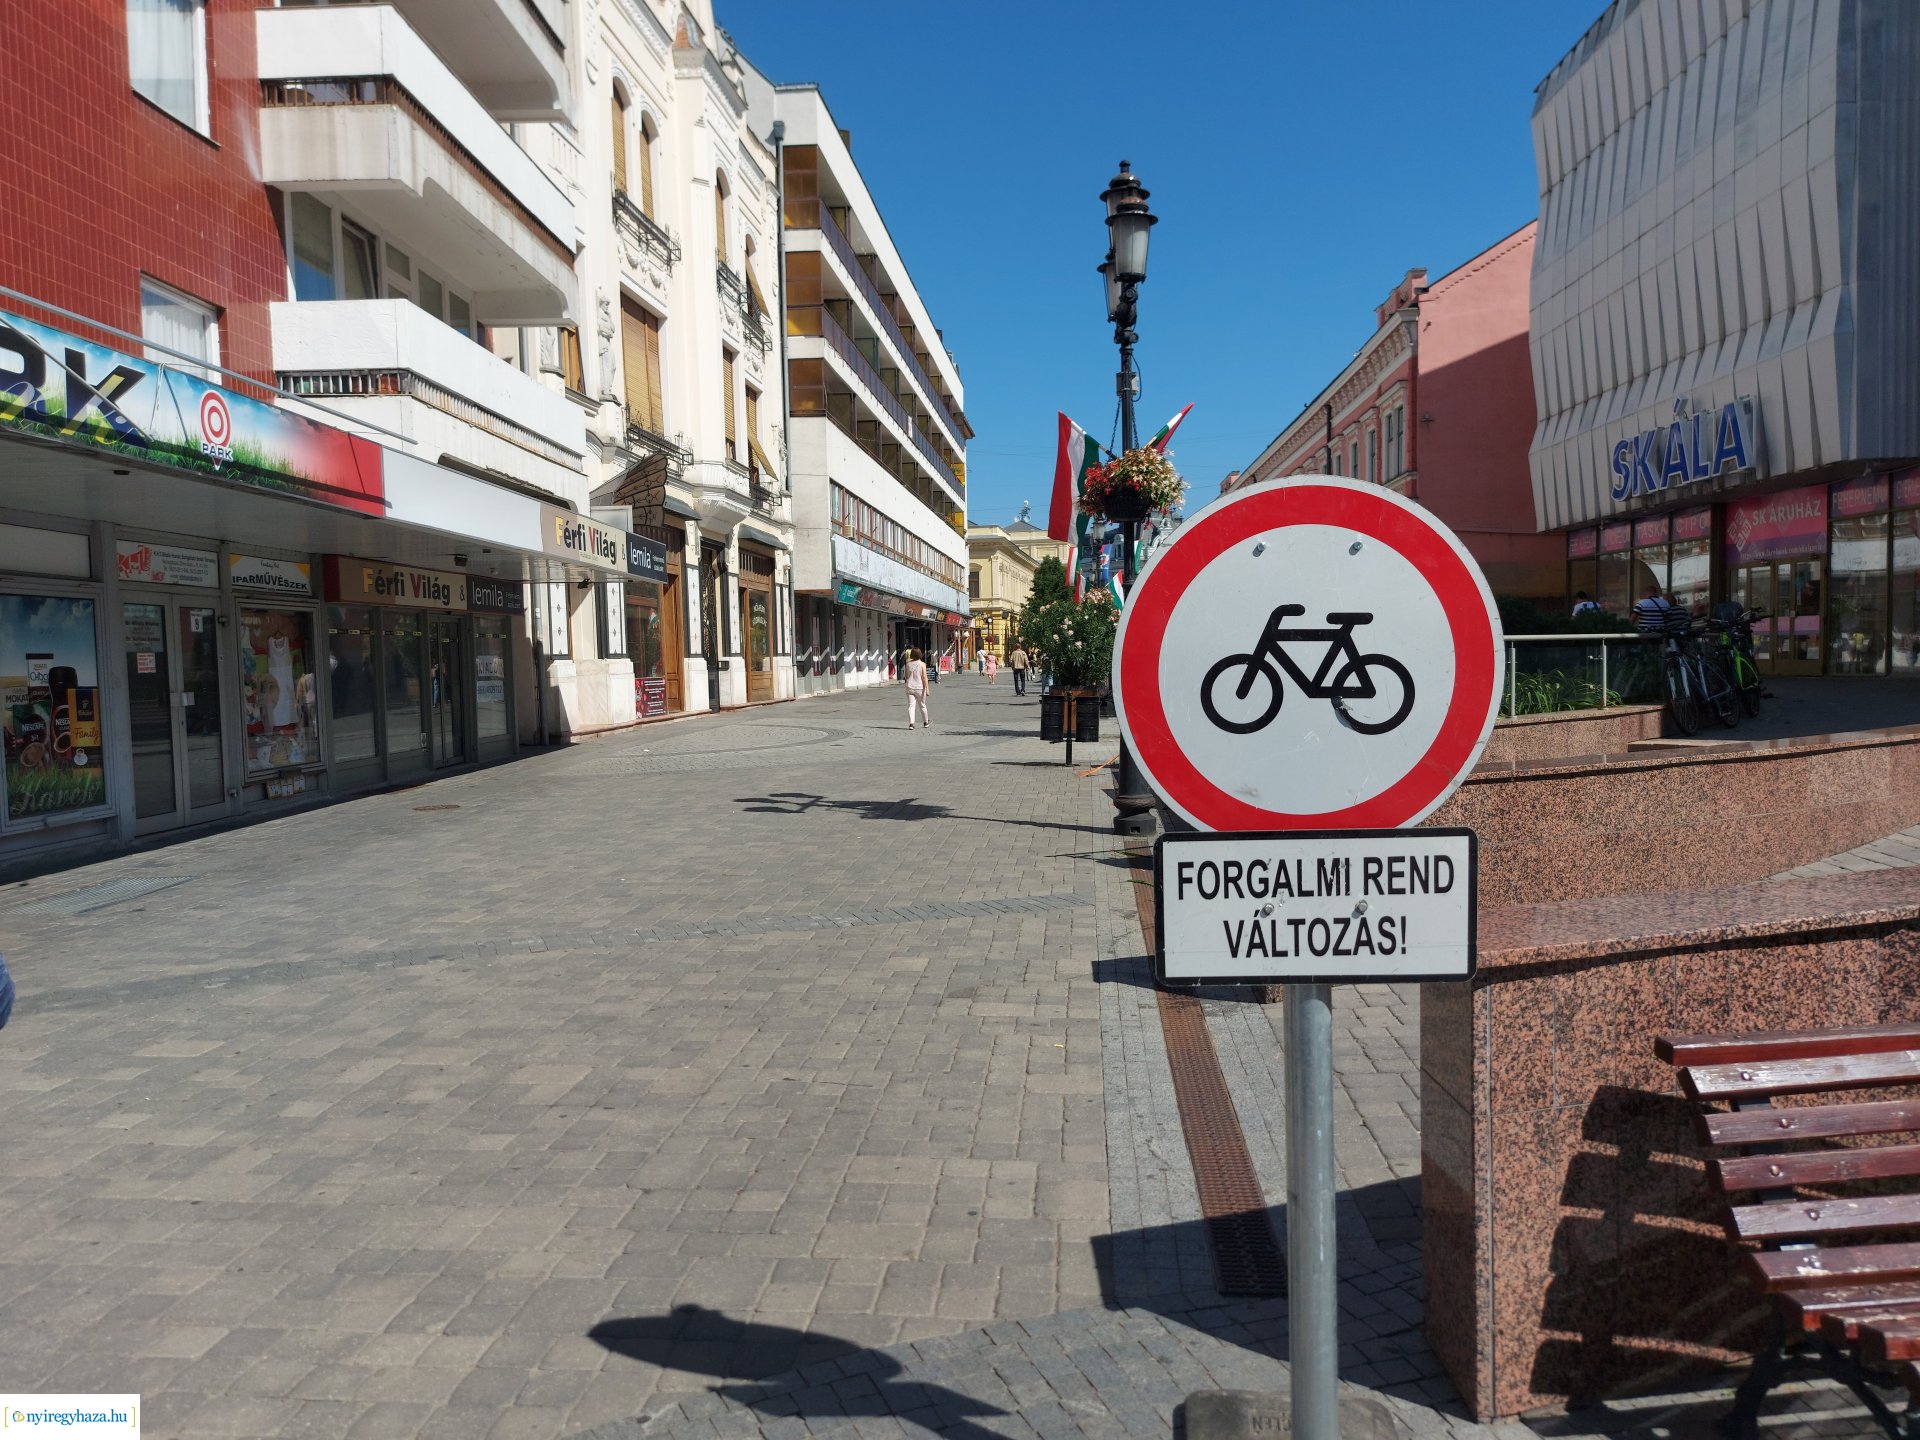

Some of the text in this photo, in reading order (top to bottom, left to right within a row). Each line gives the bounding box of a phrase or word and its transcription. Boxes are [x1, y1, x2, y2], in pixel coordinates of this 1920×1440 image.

[202, 442, 233, 461] PARK
[1611, 397, 1748, 501] SKÁLA
[1752, 496, 1822, 526] SK ÁRUHÁZ
[555, 515, 587, 552] Férfi
[588, 526, 617, 566] Világ
[232, 572, 308, 590] IPARMŰVÉSZEK
[362, 566, 405, 597] Férfi
[410, 573, 451, 606] Világ
[6, 694, 29, 703] MOKAT
[55, 718, 70, 726] NESCA
[74, 728, 98, 744] Family
[1177, 855, 1455, 900] FORGALMI REND
